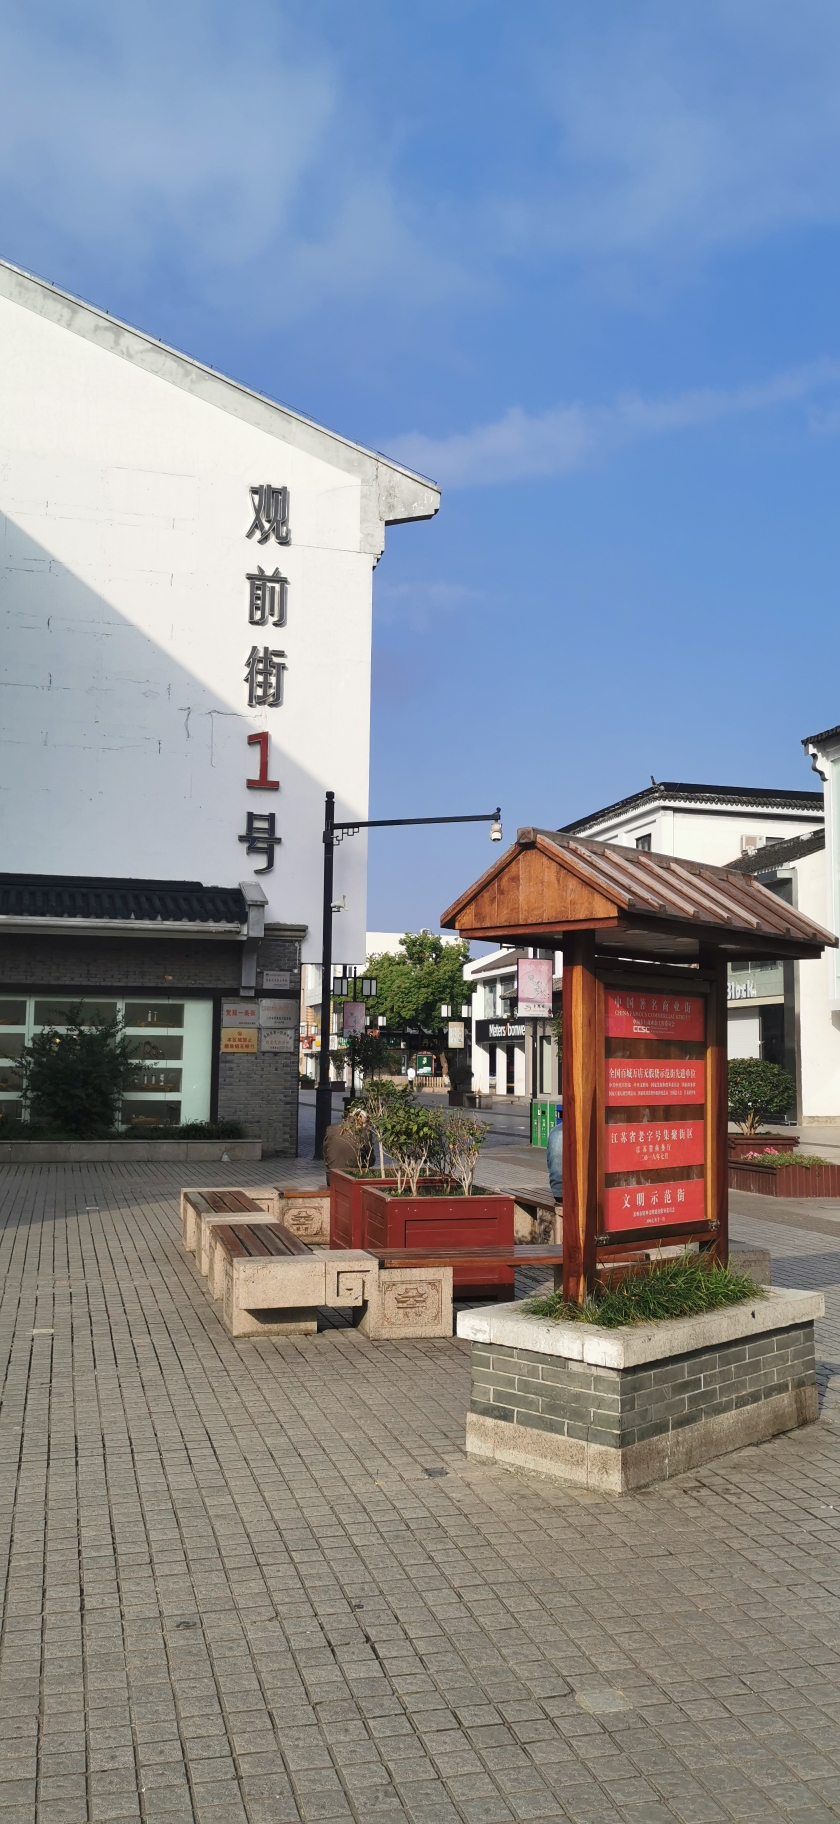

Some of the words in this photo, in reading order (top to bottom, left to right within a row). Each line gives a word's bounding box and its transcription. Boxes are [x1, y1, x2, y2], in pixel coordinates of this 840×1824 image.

[238, 483, 292, 875] 观前街1号
[614, 996, 692, 1014] 中国著名商业街
[489, 1023, 526, 1037] Meters/bonwe
[633, 1025, 650, 1033] CCSC
[611, 1128, 693, 1144] 江苏省老字号集聚街区
[622, 1188, 685, 1209] 文明示范街
